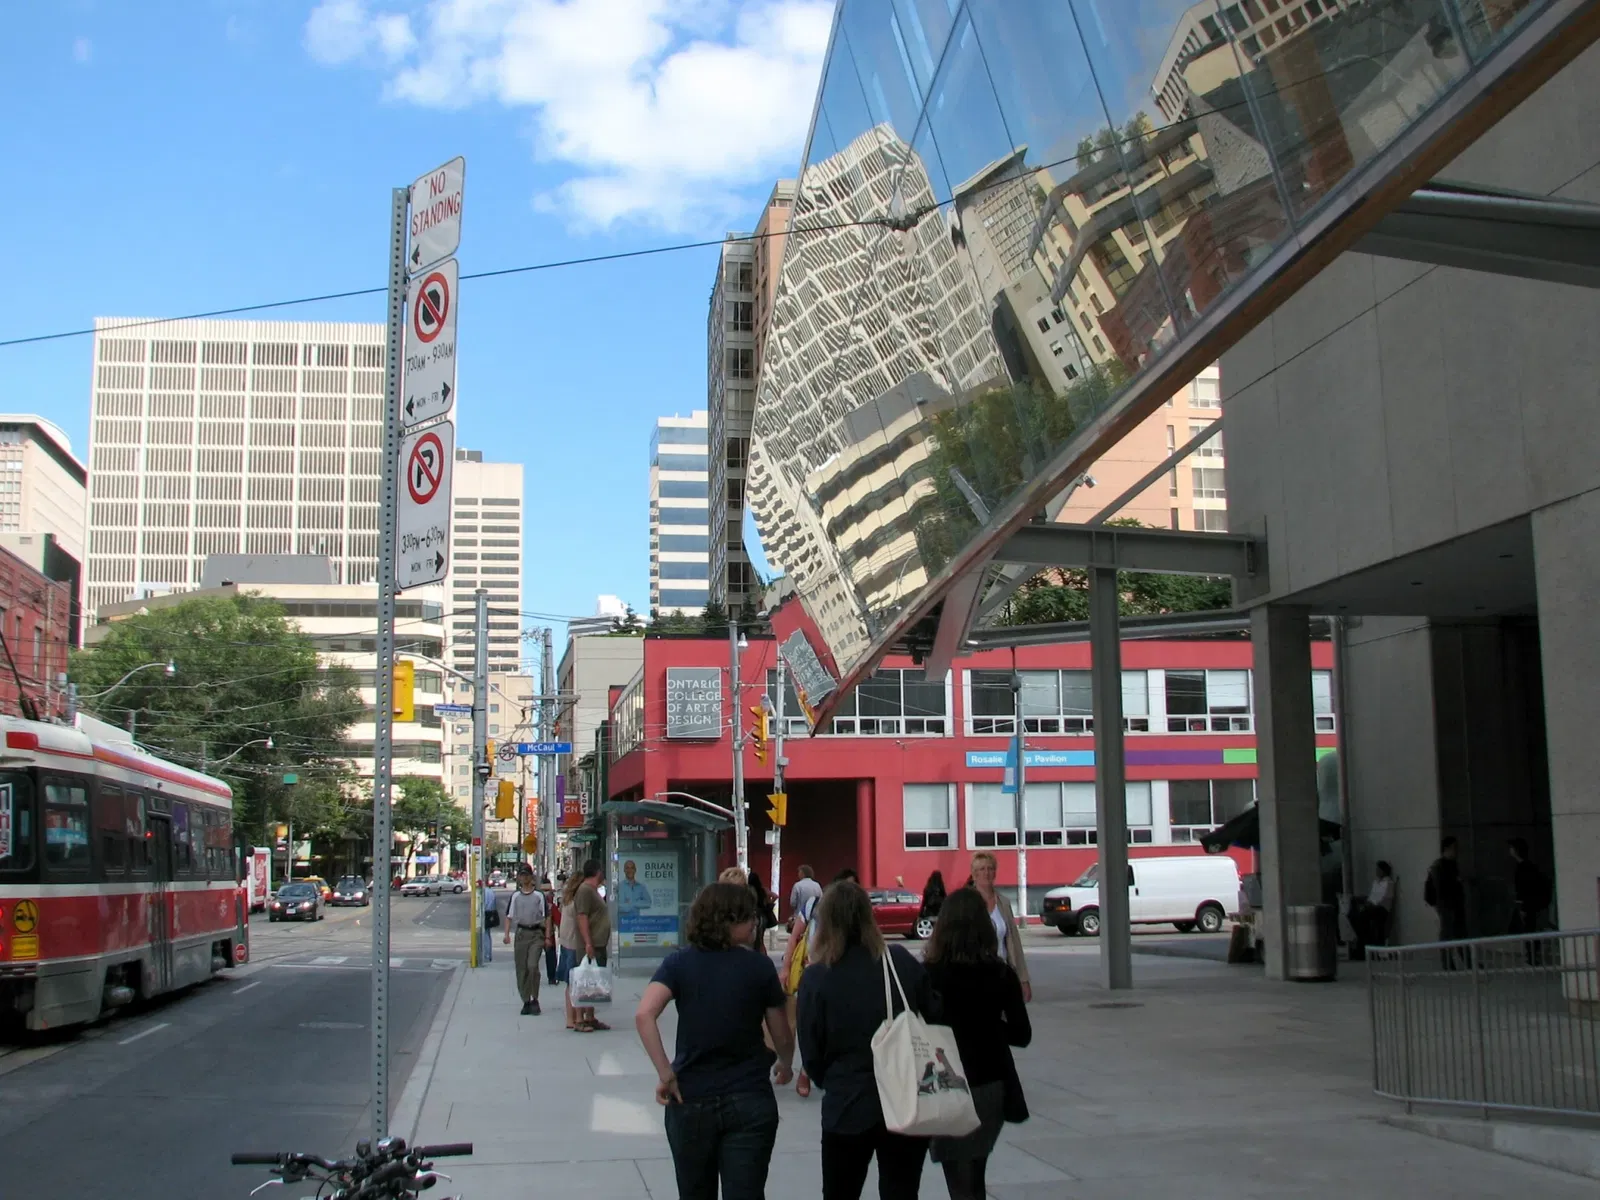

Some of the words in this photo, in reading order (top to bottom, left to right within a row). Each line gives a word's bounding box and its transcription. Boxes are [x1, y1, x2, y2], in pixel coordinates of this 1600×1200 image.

[429, 171, 446, 199] NO
[412, 191, 461, 237] STANDING
[417, 397, 426, 408] MON
[431, 391, 439, 402] FRI
[411, 562, 421, 572] MON
[668, 680, 721, 689] ONTARIO
[668, 691, 721, 701] COLLEGE
[668, 703, 682, 713] OF
[685, 703, 709, 713] ART
[711, 703, 721, 713] &
[668, 715, 712, 725] DESIGN
[527, 743, 555, 752] McCaul
[971, 755, 1003, 764] Rosalie
[1034, 755, 1067, 763] Pavilion
[645, 862, 674, 870] BRIAN
[645, 871, 675, 879] ELDER
